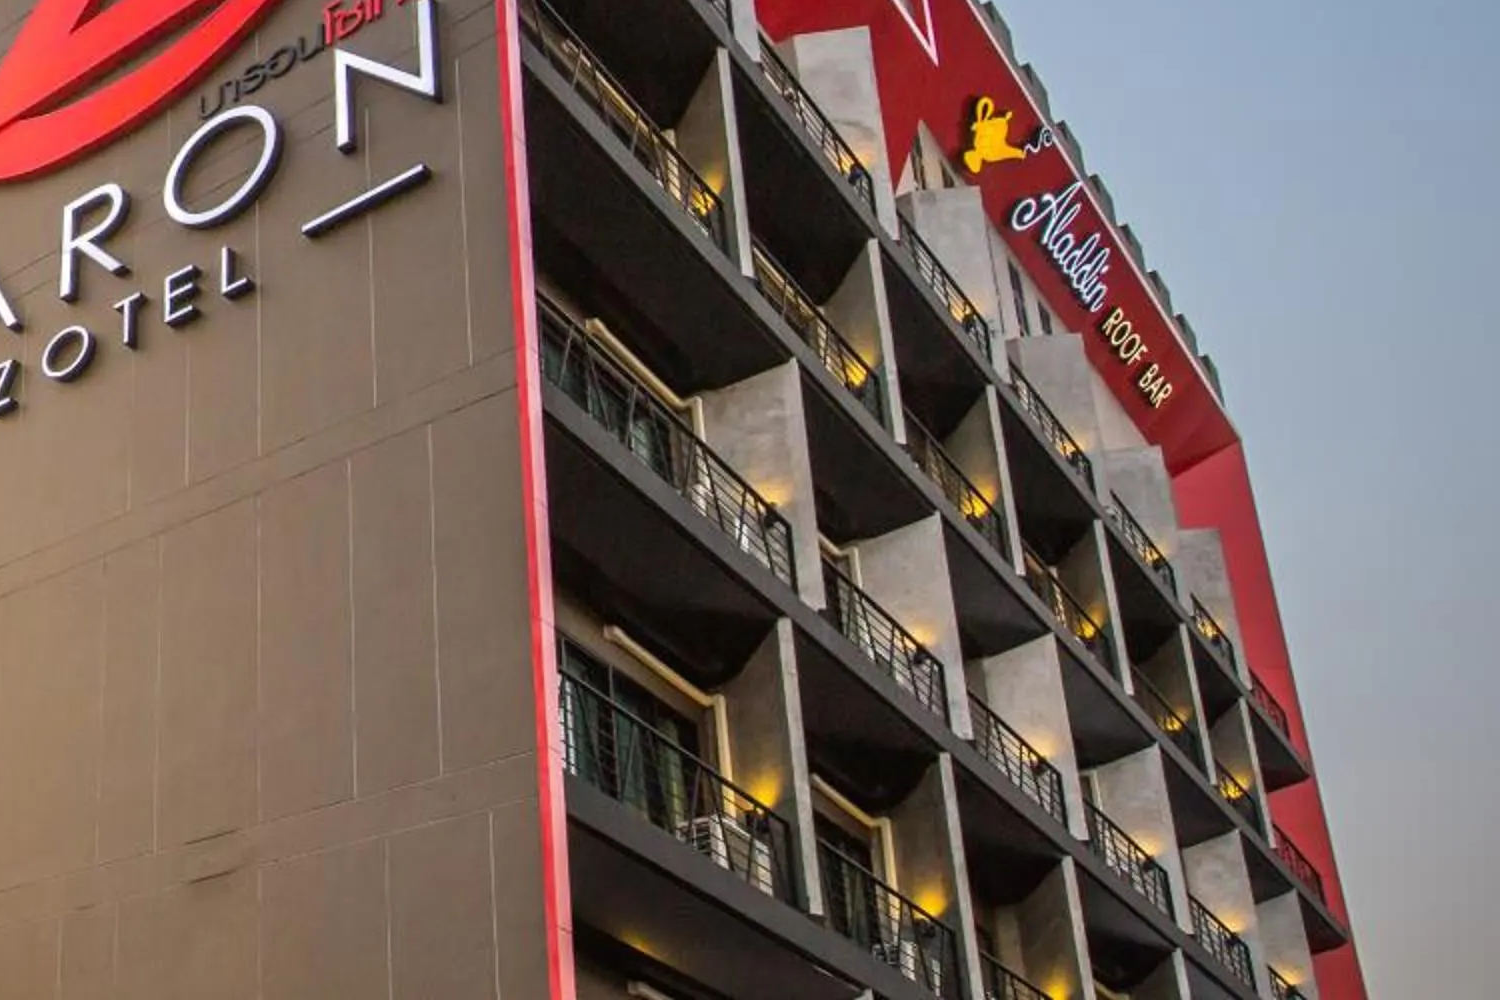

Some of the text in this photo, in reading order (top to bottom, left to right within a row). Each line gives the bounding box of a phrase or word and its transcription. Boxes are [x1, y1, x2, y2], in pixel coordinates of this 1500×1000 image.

[1011, 179, 1173, 409] Aladdin ROOF BAR
